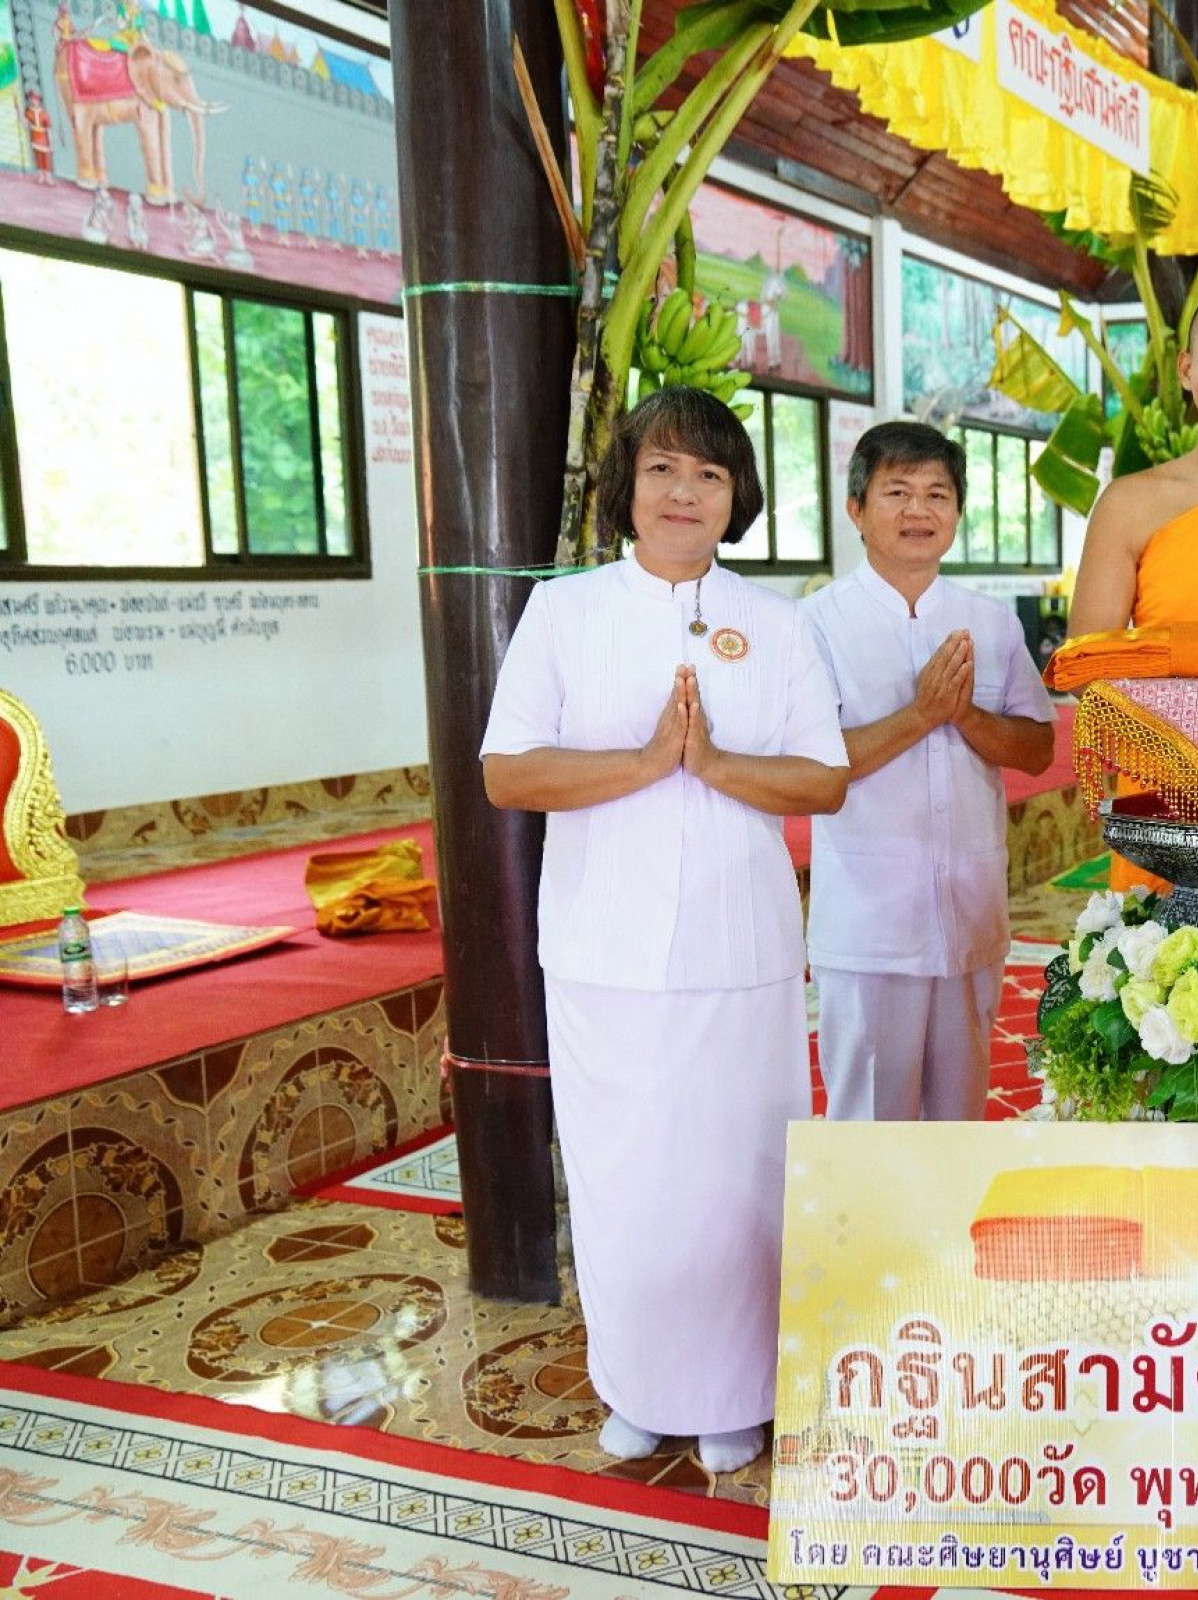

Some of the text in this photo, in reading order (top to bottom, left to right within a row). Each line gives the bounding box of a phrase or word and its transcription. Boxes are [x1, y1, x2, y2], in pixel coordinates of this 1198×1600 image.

[830, 1444, 1107, 1514] 30,000วัด
[790, 1530, 848, 1567] โดย
[863, 1534, 1125, 1581] คณะศิษยานุศิษย์
